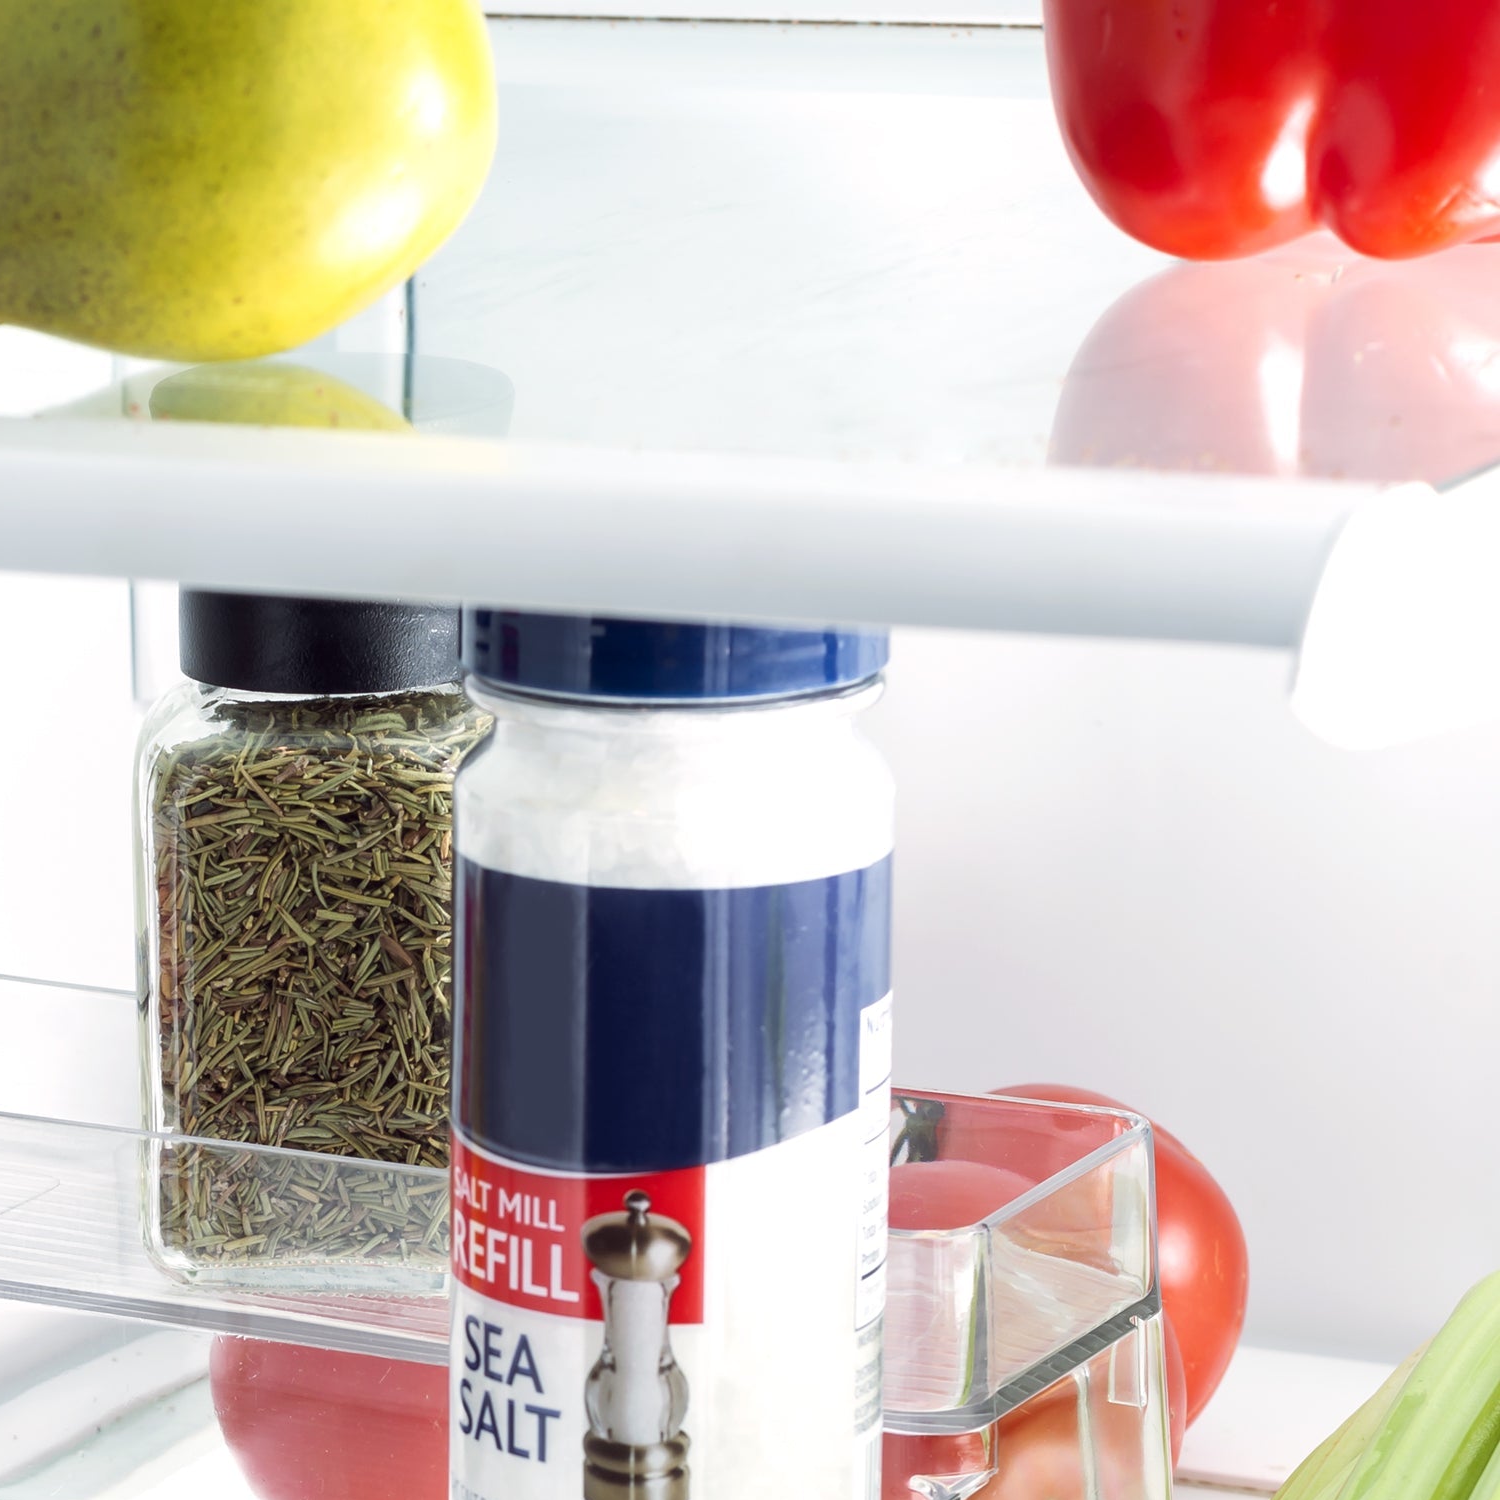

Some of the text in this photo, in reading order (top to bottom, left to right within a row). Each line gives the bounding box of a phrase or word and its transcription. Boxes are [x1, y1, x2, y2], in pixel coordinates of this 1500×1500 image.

[454, 1166, 566, 1233] SALT MILL
[454, 1208, 580, 1303] REFILL
[465, 1314, 544, 1394] SEA
[459, 1378, 562, 1463] SALT
